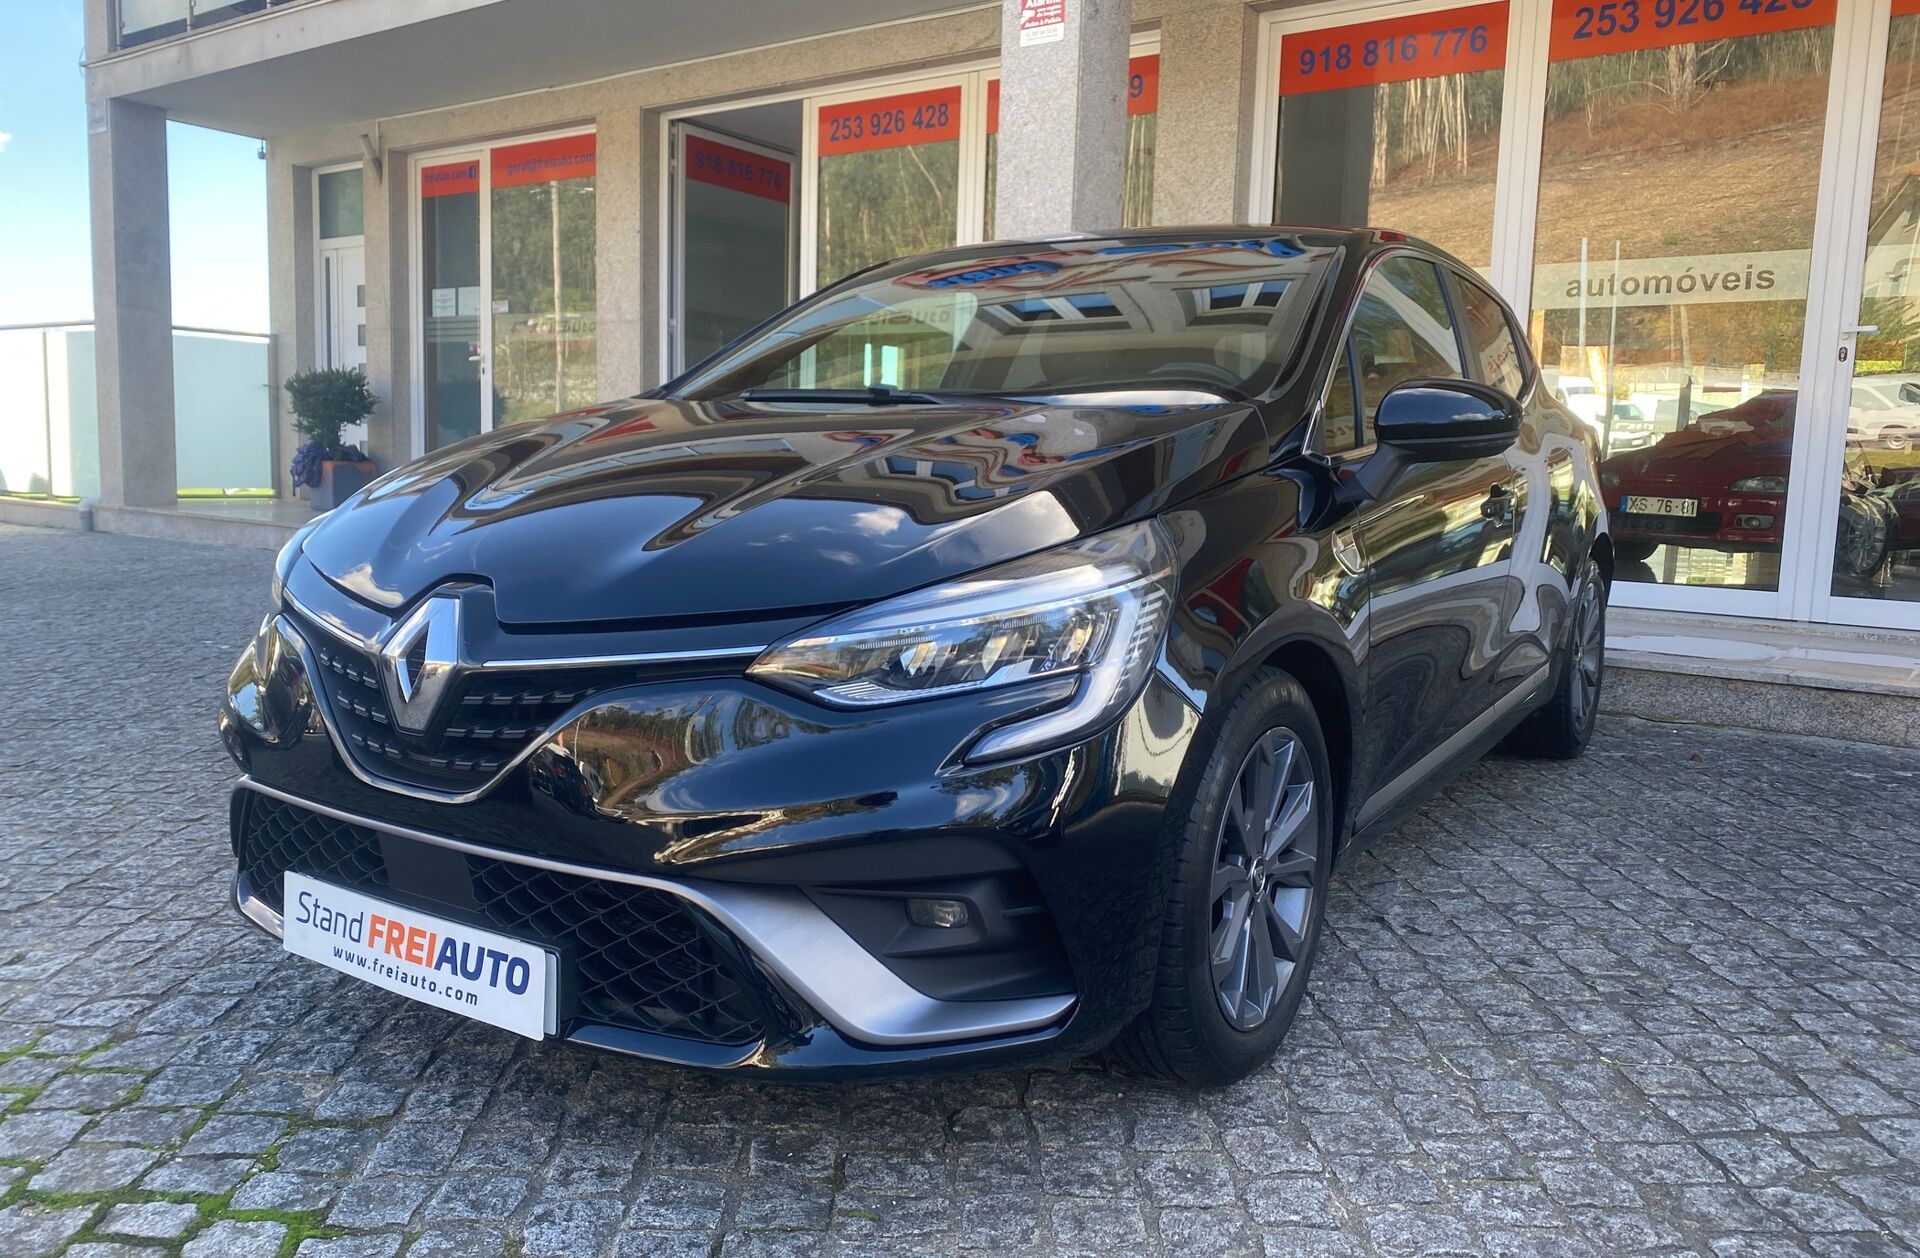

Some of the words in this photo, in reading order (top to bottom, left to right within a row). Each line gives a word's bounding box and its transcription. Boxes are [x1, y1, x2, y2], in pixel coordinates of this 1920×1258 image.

[1573, 0, 1640, 39] 253
[1299, 44, 1352, 75] 918
[1362, 34, 1417, 66] 816
[1430, 25, 1488, 58] 776
[830, 115, 863, 142] 253
[871, 110, 905, 136] 926
[912, 102, 949, 130] 428
[695, 150, 721, 174] 918
[758, 167, 783, 190] 776
[1566, 264, 1775, 298] automóveis
[295, 890, 364, 943] Stand
[367, 913, 531, 996] FREIAUTO
[333, 945, 478, 1006] www.freiauto.com
